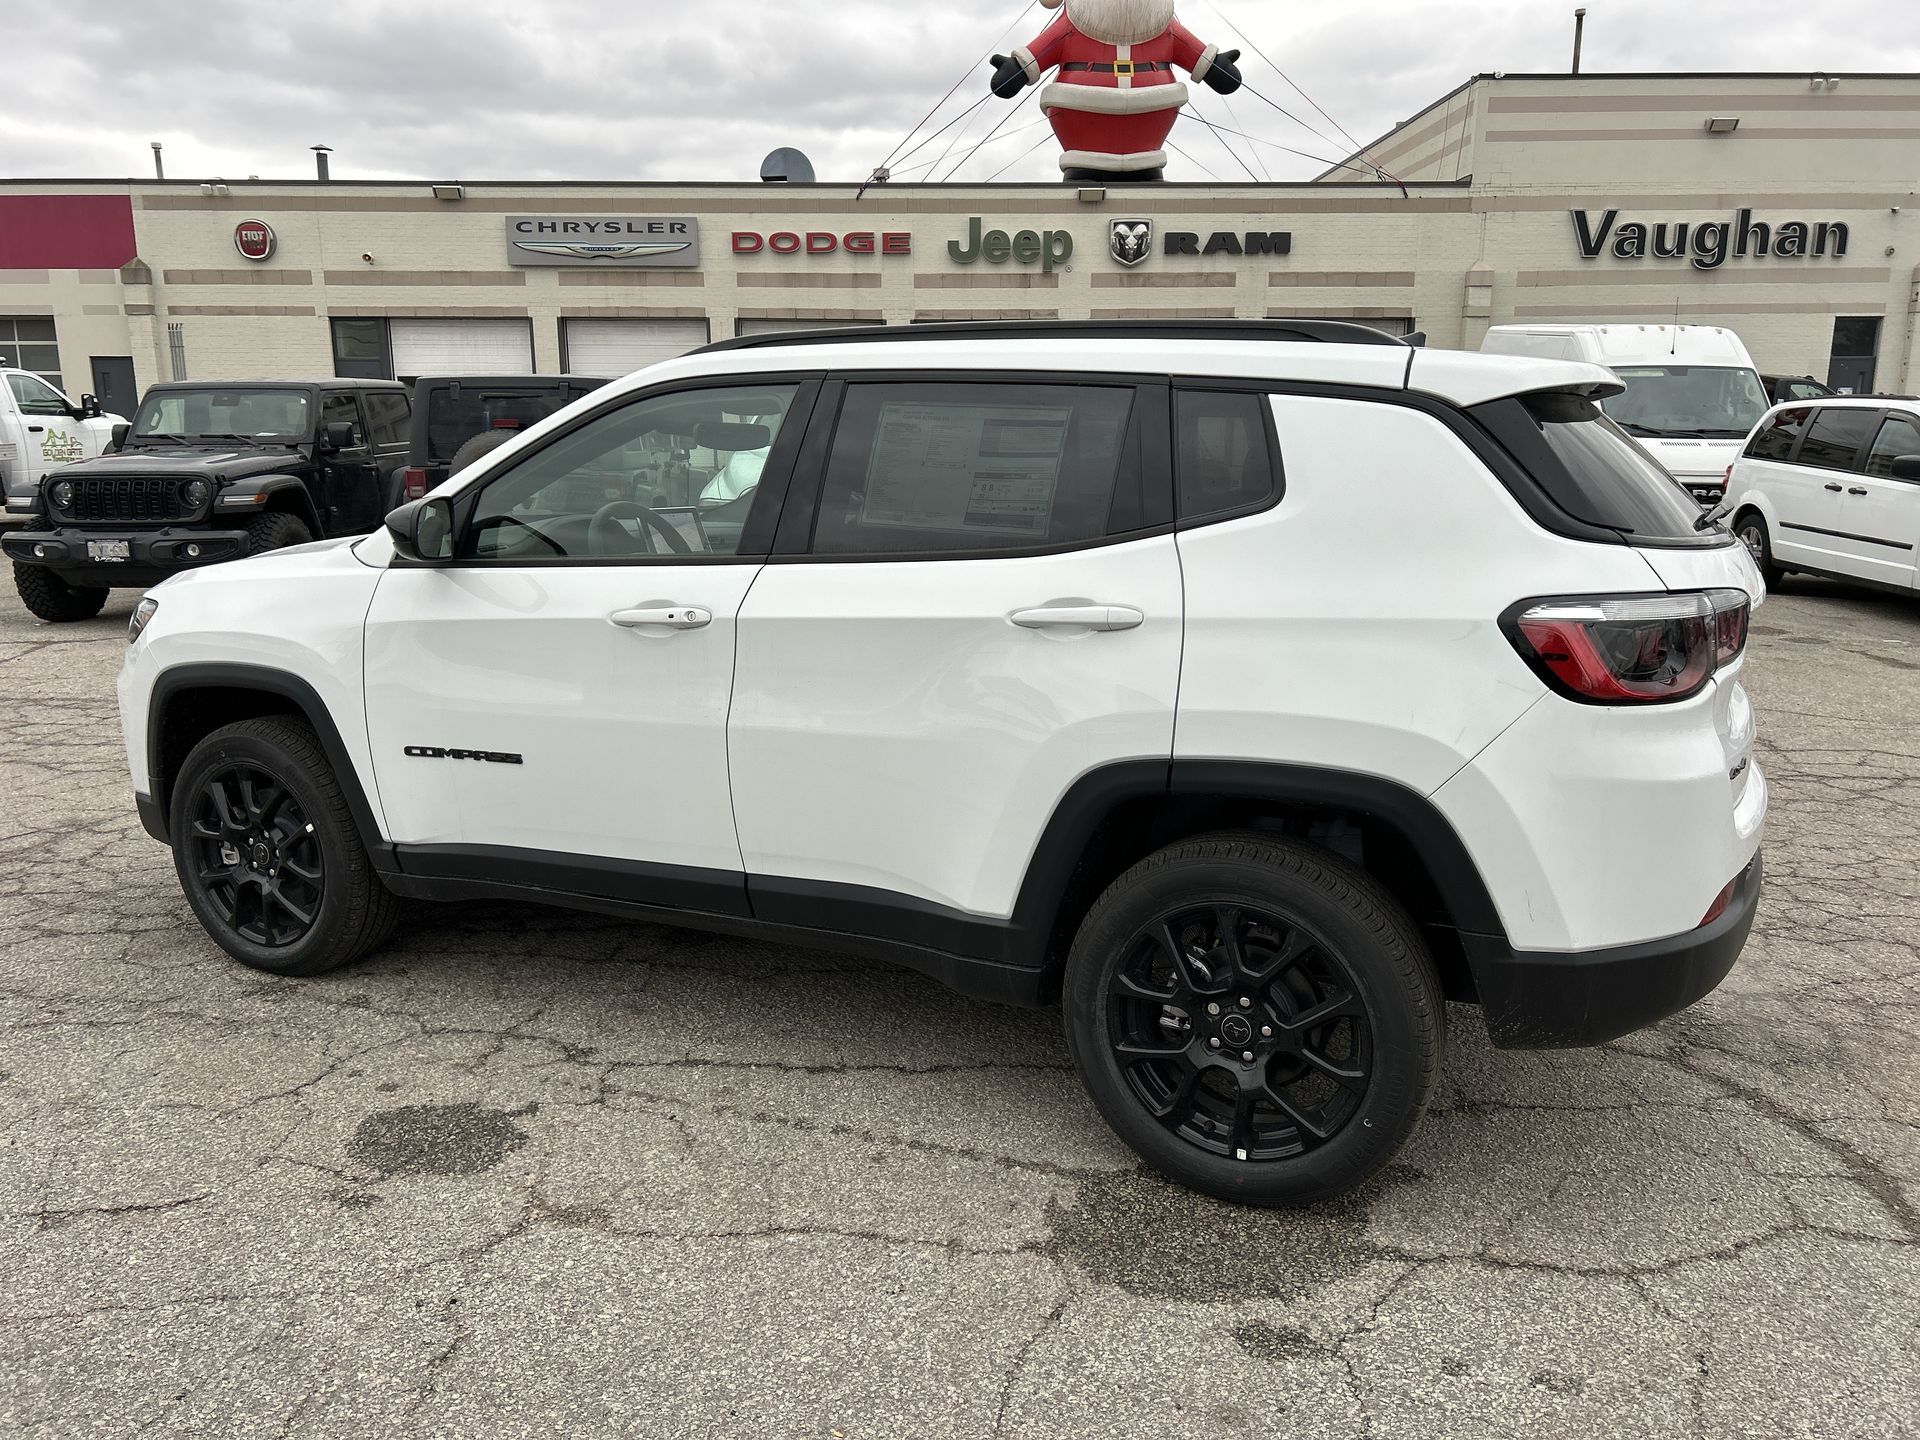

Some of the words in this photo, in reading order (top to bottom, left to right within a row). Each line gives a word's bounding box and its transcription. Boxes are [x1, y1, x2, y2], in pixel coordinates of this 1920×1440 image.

[515, 221, 687, 233] CHRYSLER
[1570, 207, 1849, 270] Vaughan
[731, 231, 911, 254] DODGE
[947, 216, 1073, 273] Jeep
[1164, 231, 1292, 254] RAM
[43, 448, 66, 457] GOLDEN
[67, 448, 83, 456] GATE
[404, 745, 523, 764] COMPASS
